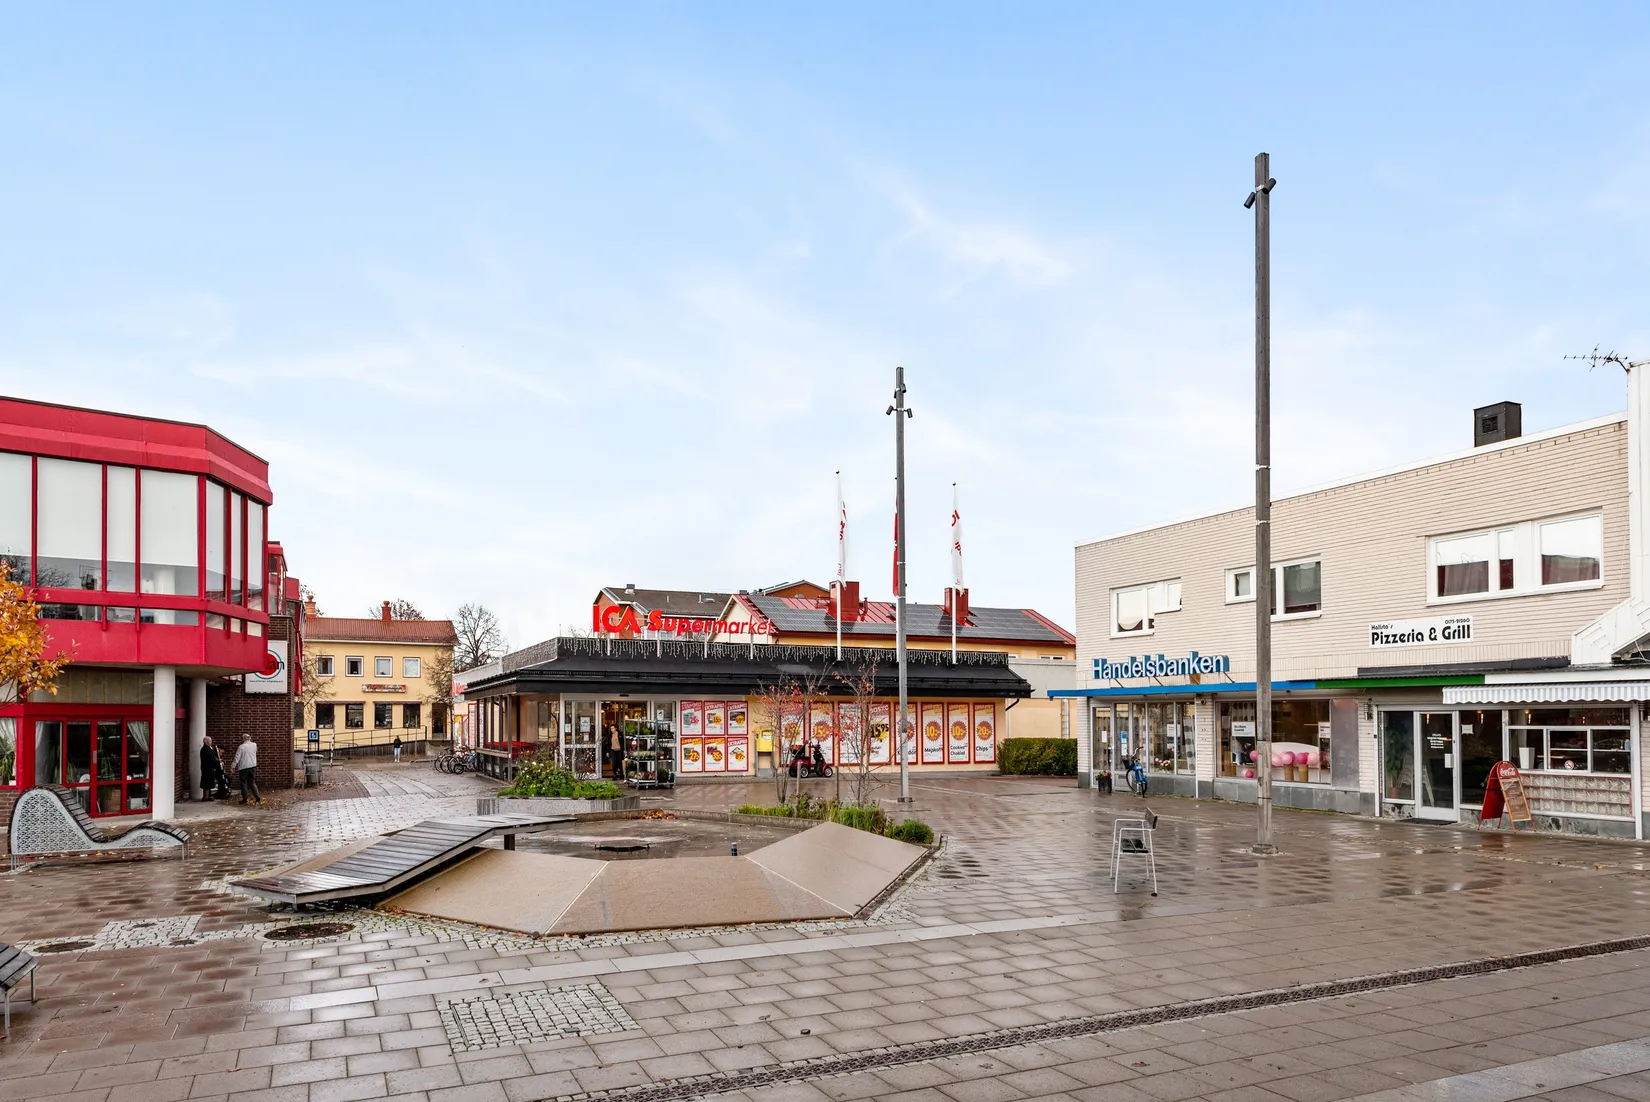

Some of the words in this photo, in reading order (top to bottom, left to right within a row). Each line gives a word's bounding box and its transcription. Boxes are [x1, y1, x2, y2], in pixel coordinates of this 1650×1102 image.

[593, 605, 641, 633] ICA
[648, 610, 776, 636] Supermarket
[1371, 629, 1425, 645] Pizzeria
[1428, 627, 1438, 641] &
[1442, 624, 1471, 640] Grill
[1092, 651, 1229, 679] Handelsbanken
